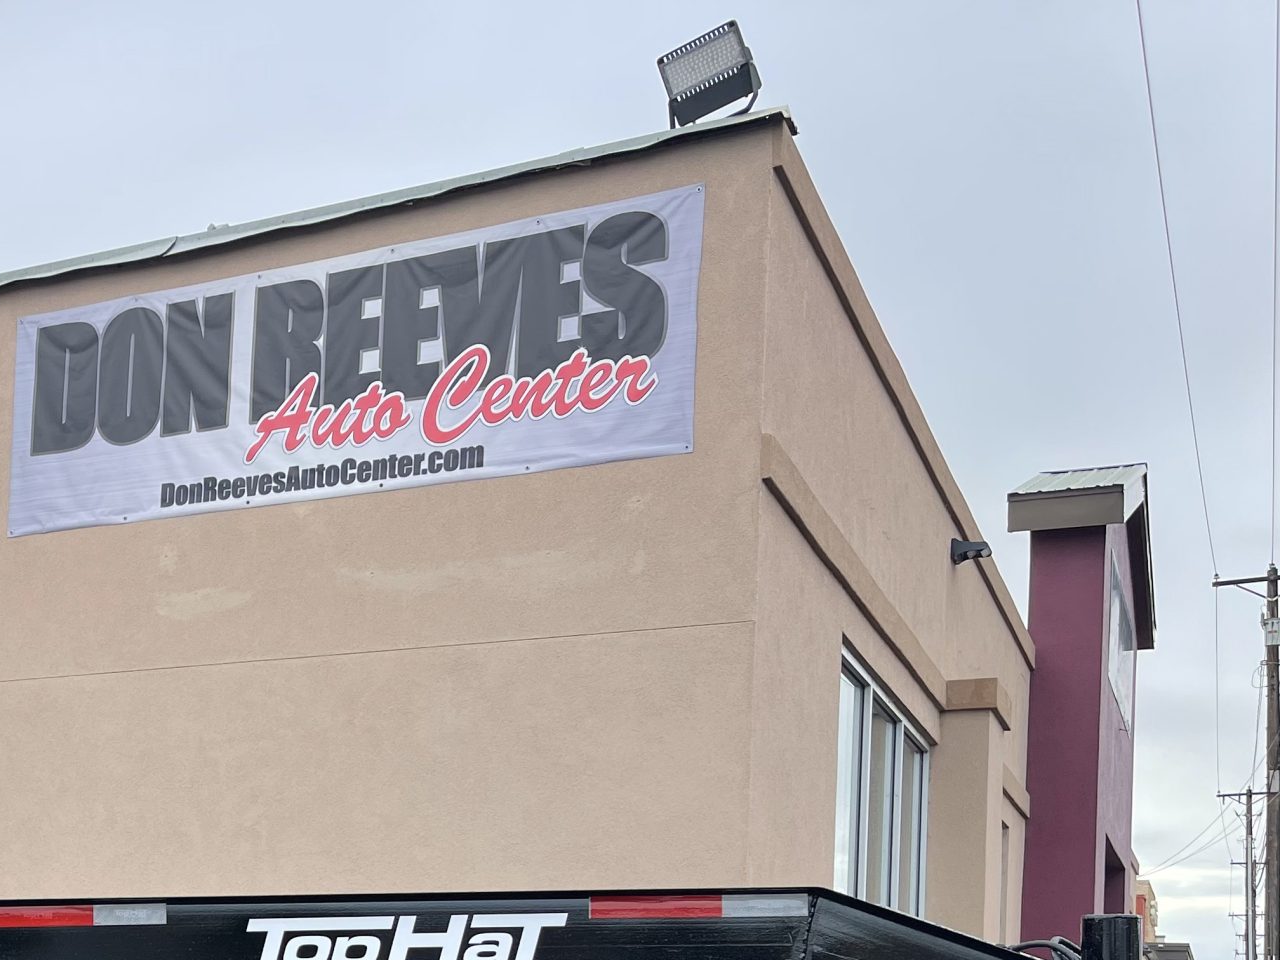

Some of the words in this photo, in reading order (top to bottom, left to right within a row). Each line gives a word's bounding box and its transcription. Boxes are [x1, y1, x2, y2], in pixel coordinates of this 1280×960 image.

[30, 290, 236, 456] DON
[249, 211, 669, 424] REEVES
[243, 372, 412, 464] Auto
[420, 344, 658, 446] Center
[160, 444, 484, 508] DonReevesAutoCenter.com
